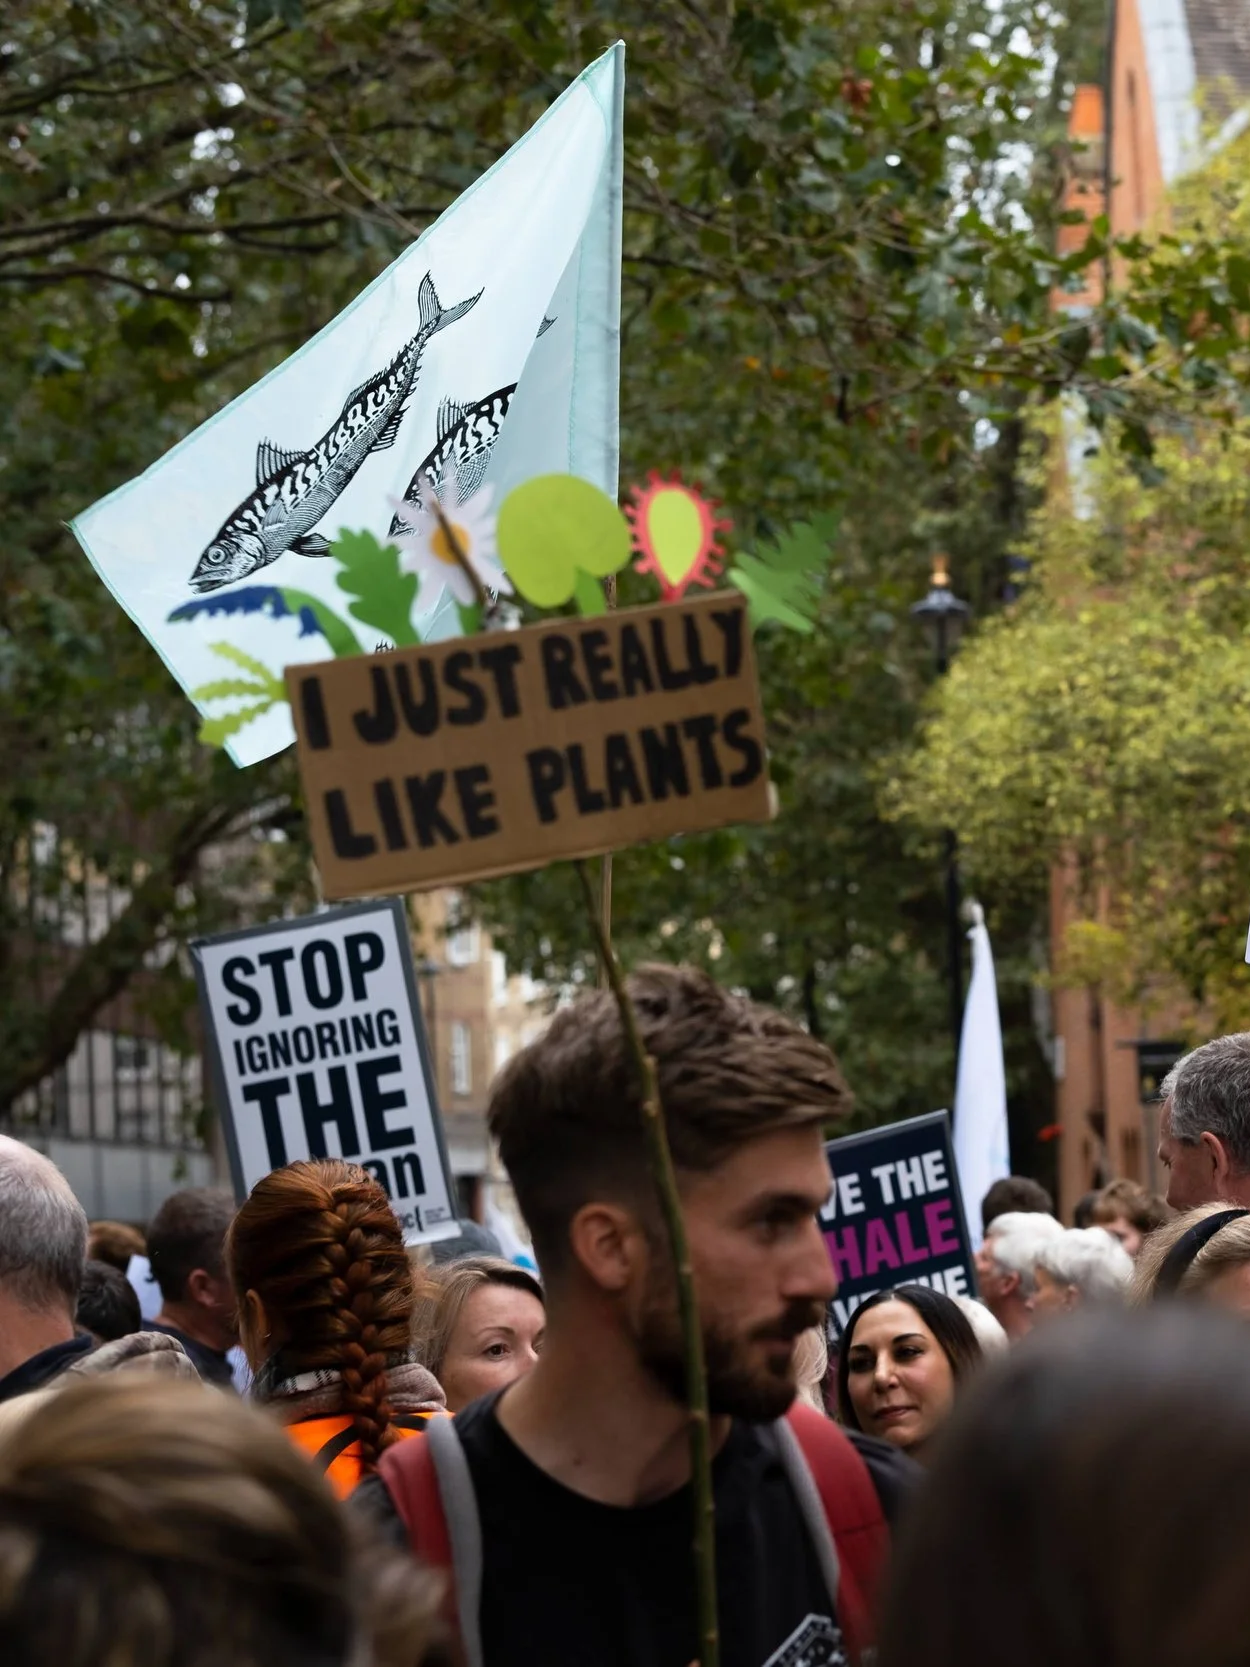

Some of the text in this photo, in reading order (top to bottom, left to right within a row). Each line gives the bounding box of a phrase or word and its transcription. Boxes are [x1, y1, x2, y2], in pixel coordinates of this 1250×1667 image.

[301, 606, 745, 750] I JUST REALLY
[322, 708, 763, 861] LIKE PLANTS
[221, 931, 385, 1027] STOP
[234, 1008, 402, 1077] IGNORING
[242, 1054, 417, 1171] THE
[819, 1149, 949, 1222] VE THE
[822, 1199, 960, 1284] HALE
